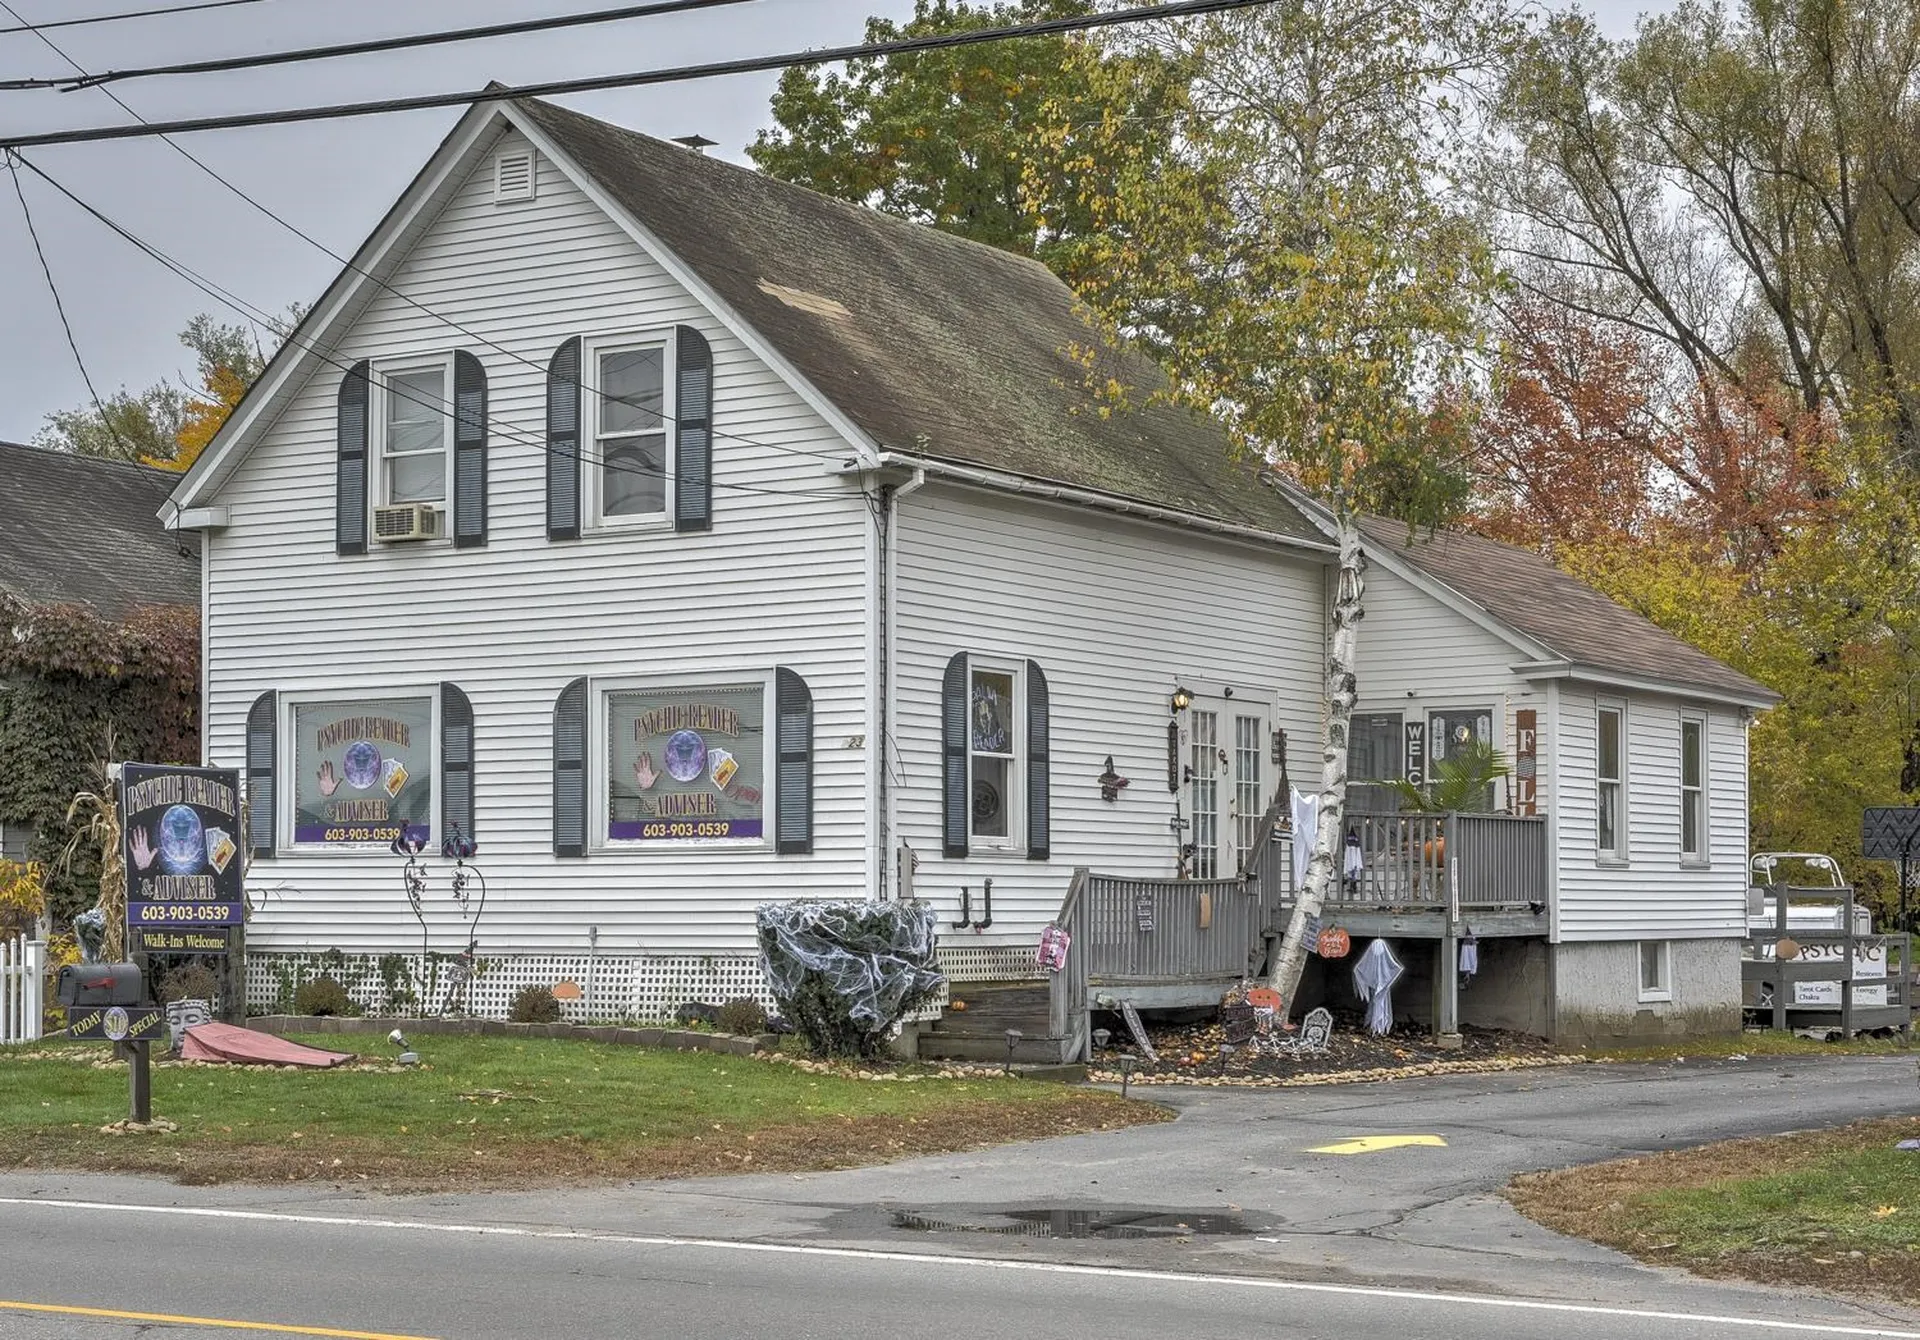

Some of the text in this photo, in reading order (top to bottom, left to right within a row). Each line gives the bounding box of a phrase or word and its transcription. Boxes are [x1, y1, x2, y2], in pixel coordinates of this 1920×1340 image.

[317, 716, 411, 751] PSYCHIC READER
[634, 703, 740, 741] PSYCHIC READER
[973, 729, 1005, 751] READER
[127, 775, 236, 817] PSYCHIC READER
[655, 792, 717, 818] ADVISER
[335, 799, 389, 822] ADVISER
[325, 828, 400, 841] 603-903-0539
[643, 822, 729, 837] 603-903-0539
[141, 875, 217, 901] & ADVISER
[141, 905, 229, 920] 603-903-0539
[143, 933, 225, 949] Walk-Ins Welcome
[71, 1010, 161, 1037] TODAY $10 SPECIAL
